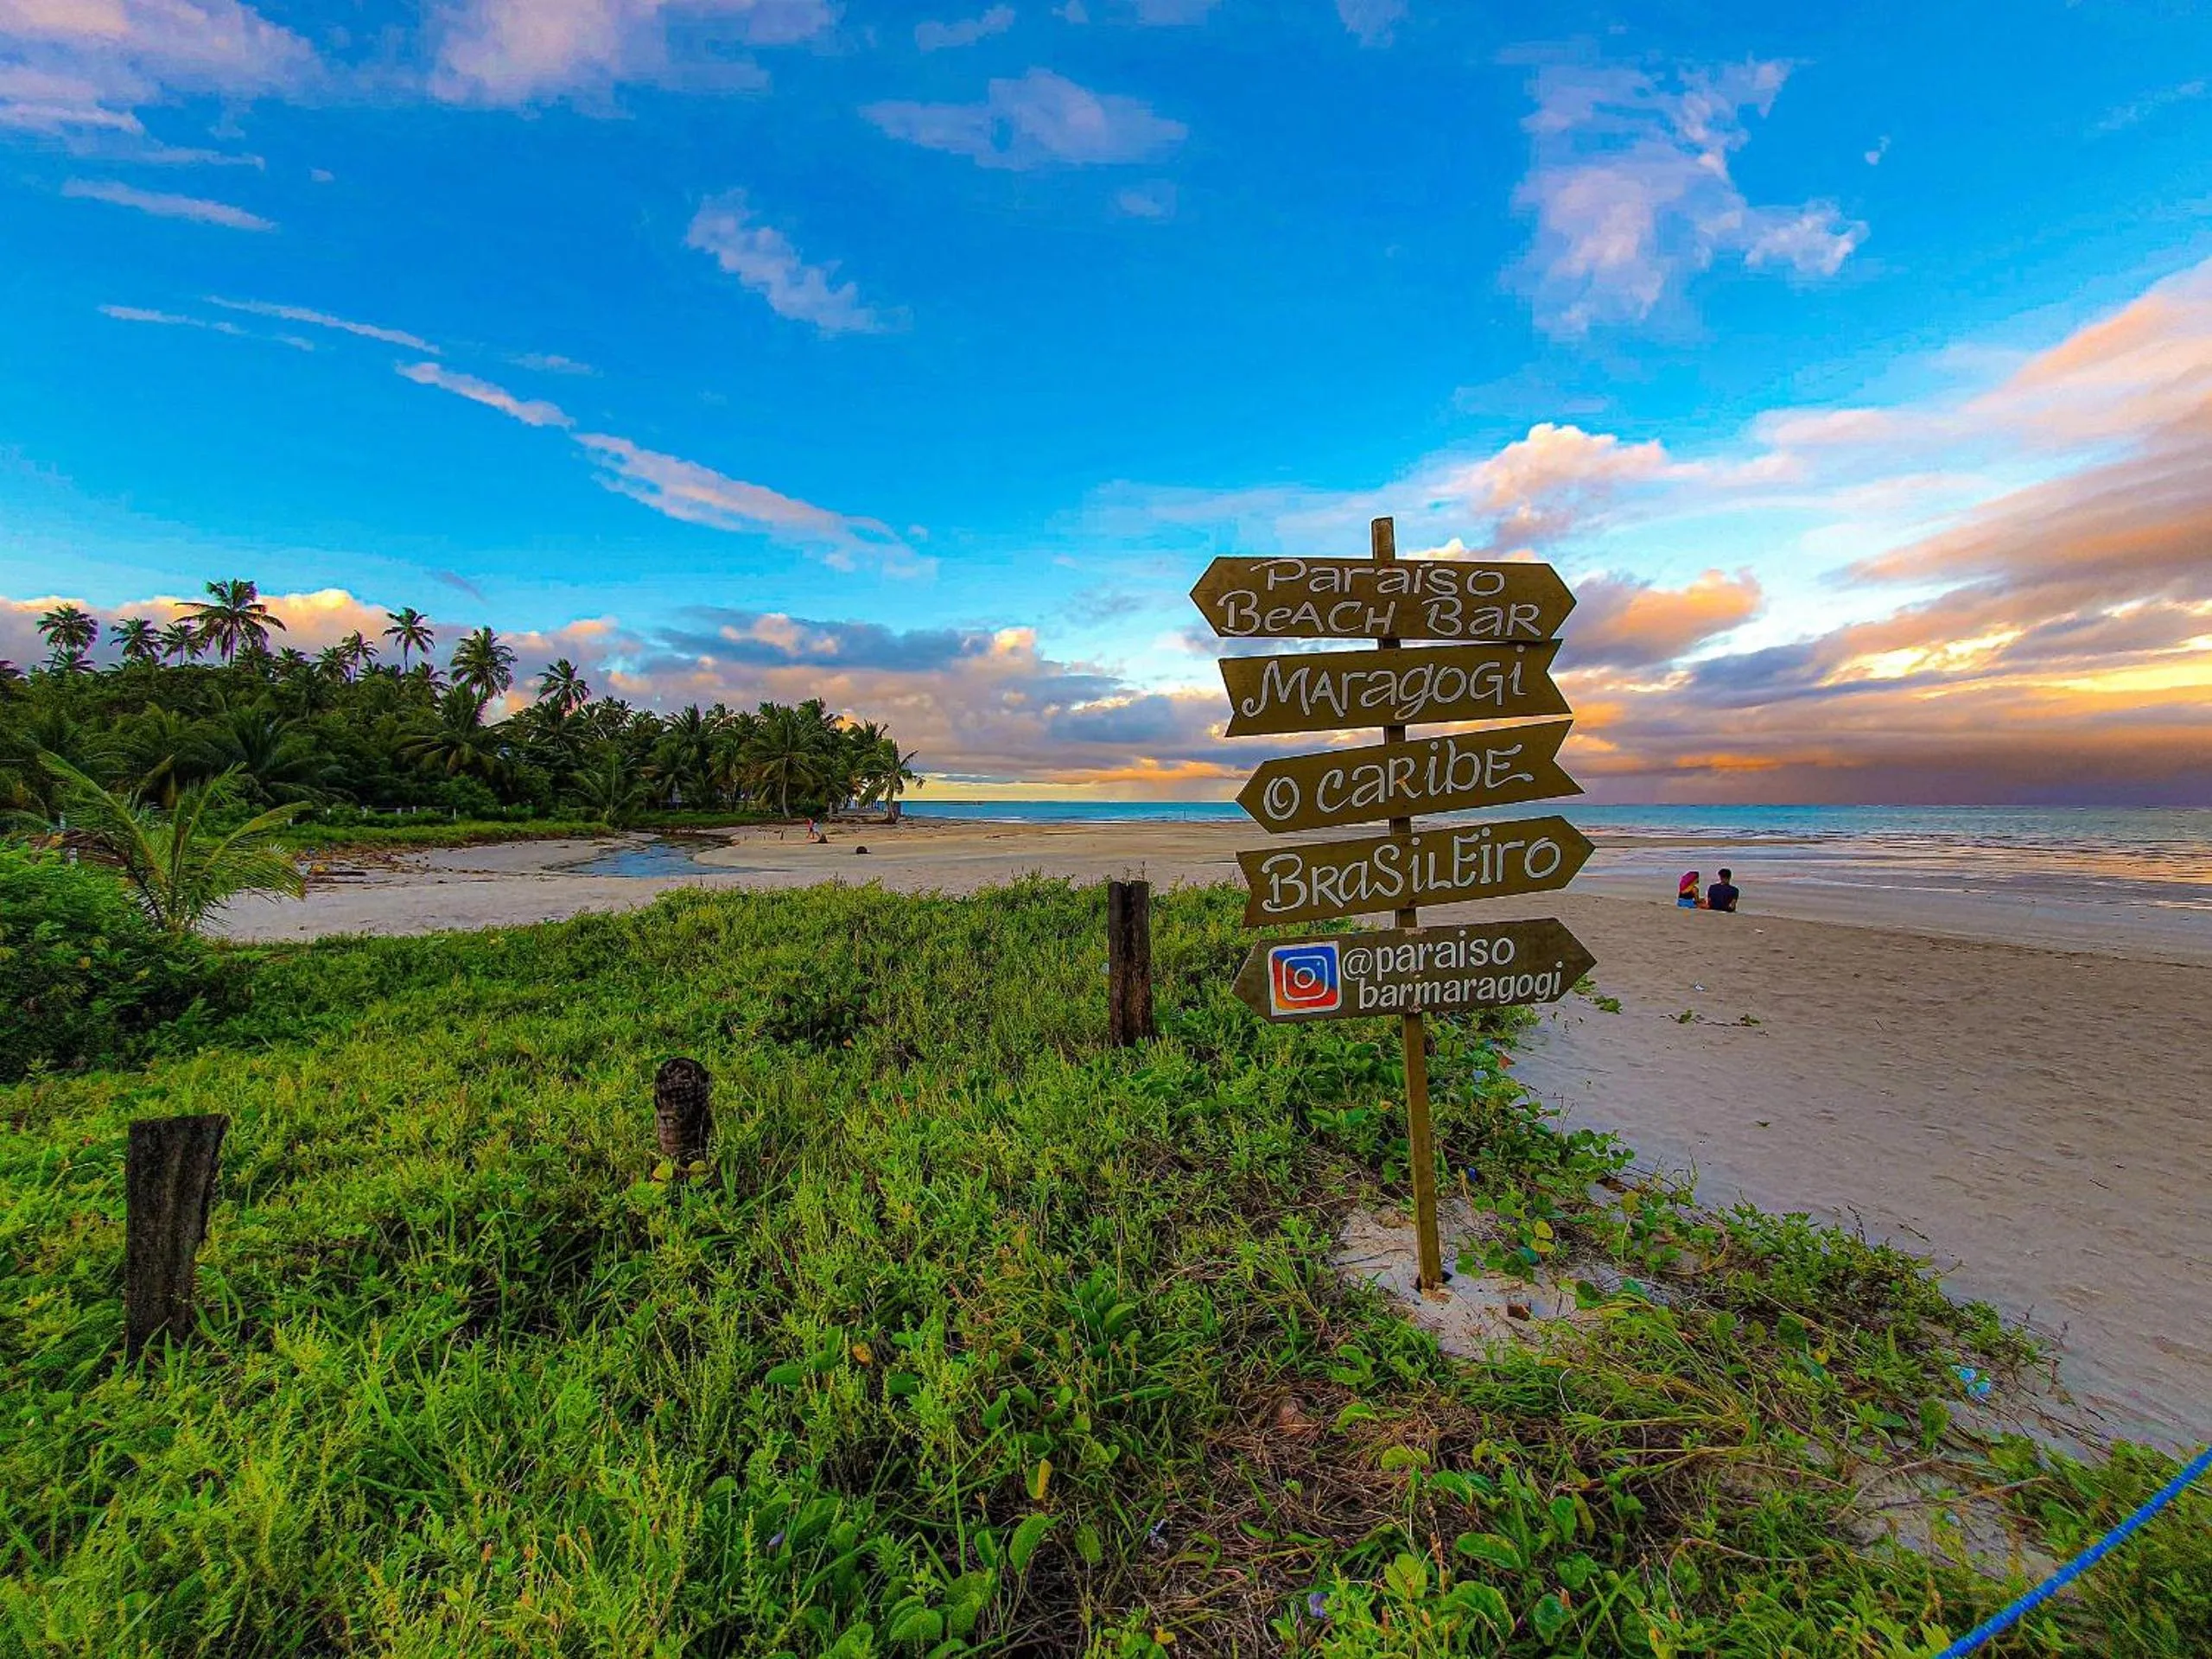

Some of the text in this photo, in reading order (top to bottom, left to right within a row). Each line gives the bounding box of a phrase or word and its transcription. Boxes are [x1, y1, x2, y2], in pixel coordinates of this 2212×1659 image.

[1263, 777, 1300, 820] O
[1343, 930, 1516, 981] @paraiso
[1358, 961, 1563, 1009] barmaragogi
